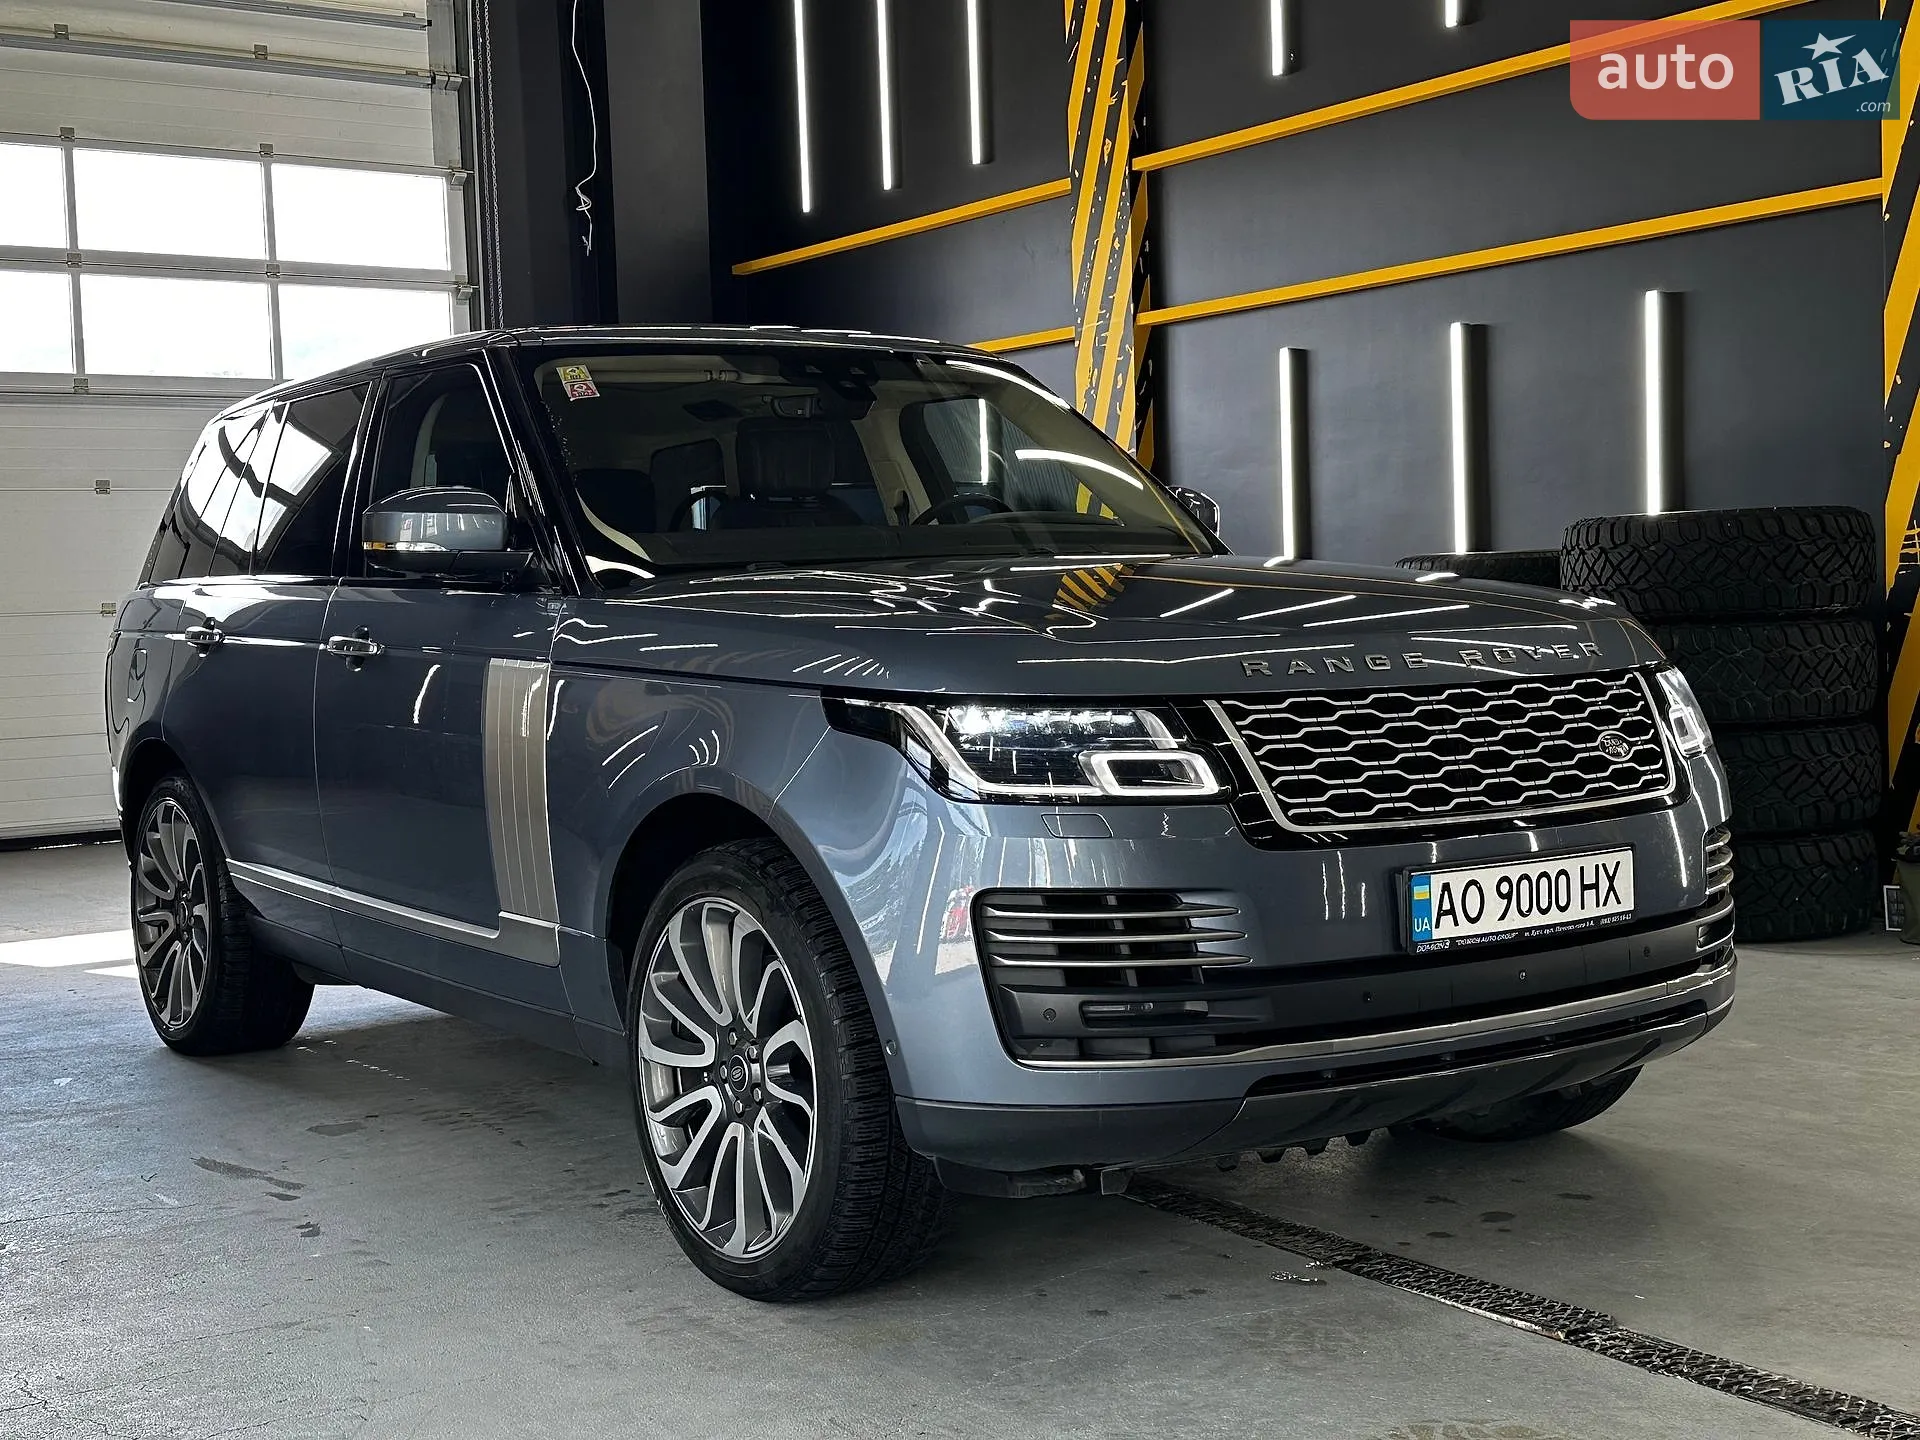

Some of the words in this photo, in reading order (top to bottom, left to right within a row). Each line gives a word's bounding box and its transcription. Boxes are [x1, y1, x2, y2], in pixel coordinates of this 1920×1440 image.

[1240, 652, 1429, 678] RANGE
[1458, 641, 1603, 668] ROVER
[1435, 879, 1485, 930] AO
[1496, 868, 1571, 922] 9000
[1579, 860, 1622, 911] HX
[1414, 917, 1431, 933] UA
